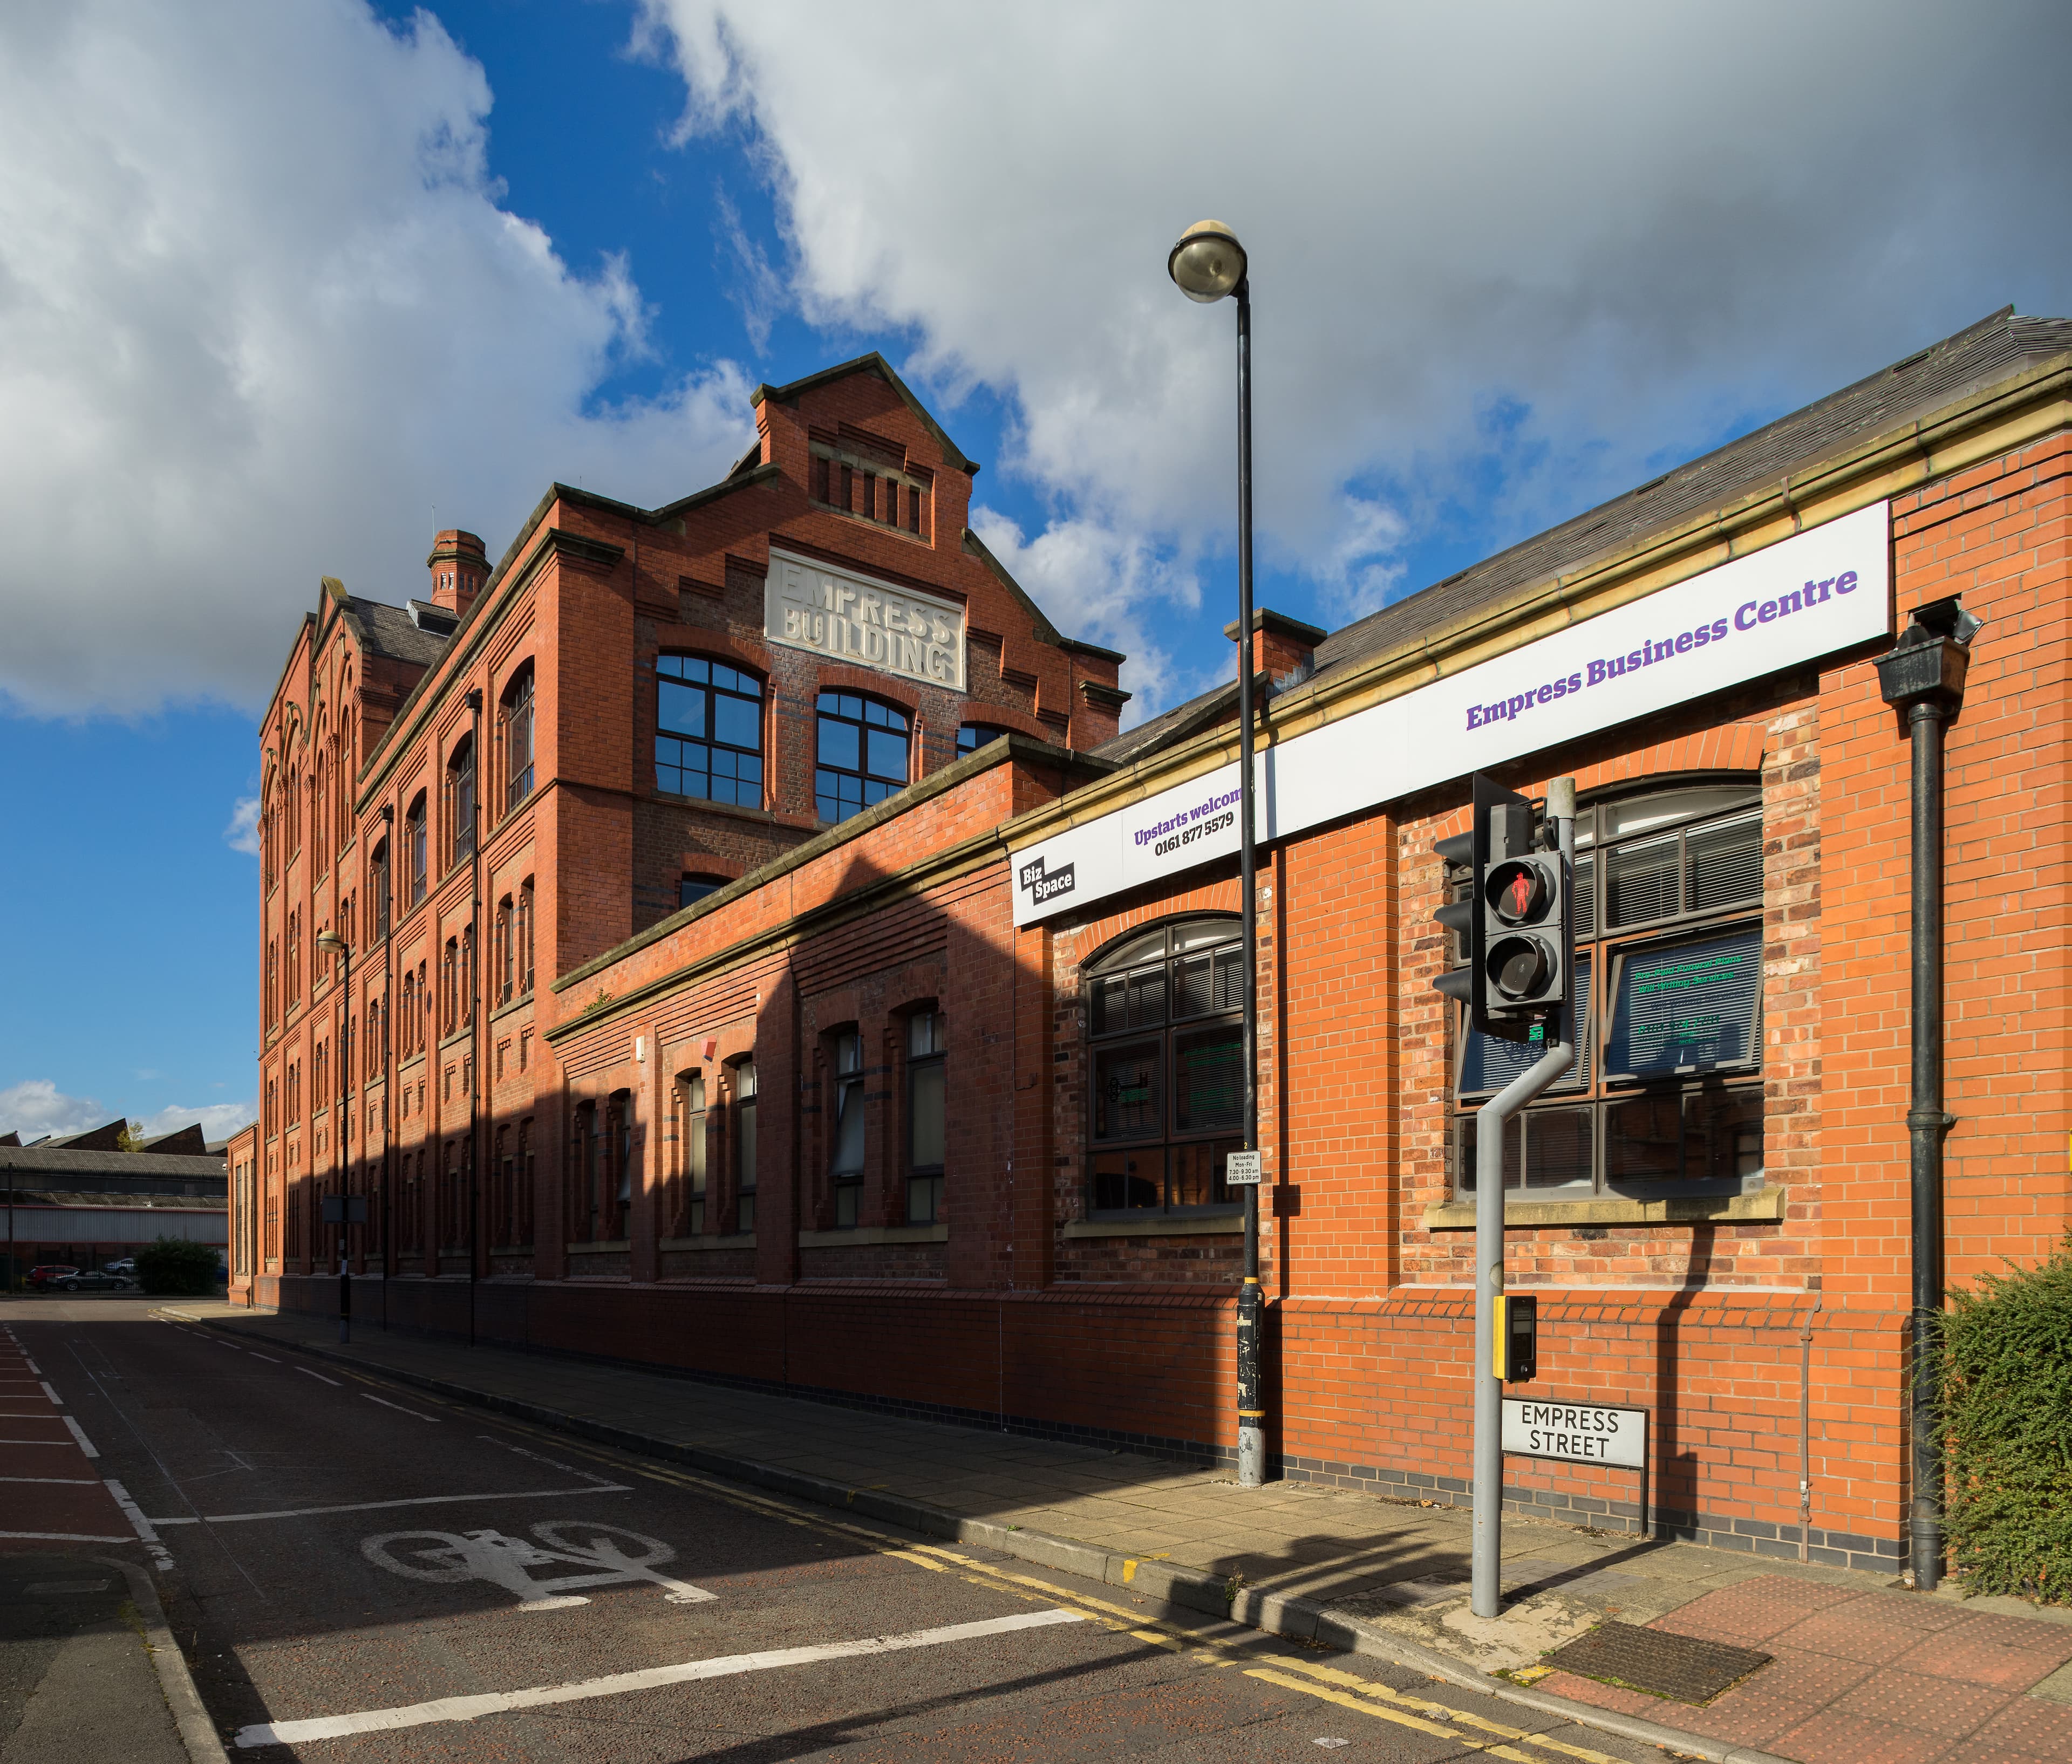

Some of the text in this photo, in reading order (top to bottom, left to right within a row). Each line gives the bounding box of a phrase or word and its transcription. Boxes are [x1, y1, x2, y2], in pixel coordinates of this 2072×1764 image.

[781, 561, 951, 644] EMPRESS
[782, 605, 948, 680] BUILDING
[1466, 571, 1858, 731] Empress Business Centre
[1134, 788, 1242, 846] Upstarts welcom
[1155, 811, 1234, 857] 0161 877 5579
[1023, 866, 1042, 885] Biz
[1035, 873, 1072, 899] Space
[1635, 955, 1742, 981] Pre-Paid Funeral Plans
[1638, 972, 1734, 994] Will Writing Services
[1522, 1404, 1619, 1433] EMPRESS
[1529, 1430, 1610, 1458] STREET
